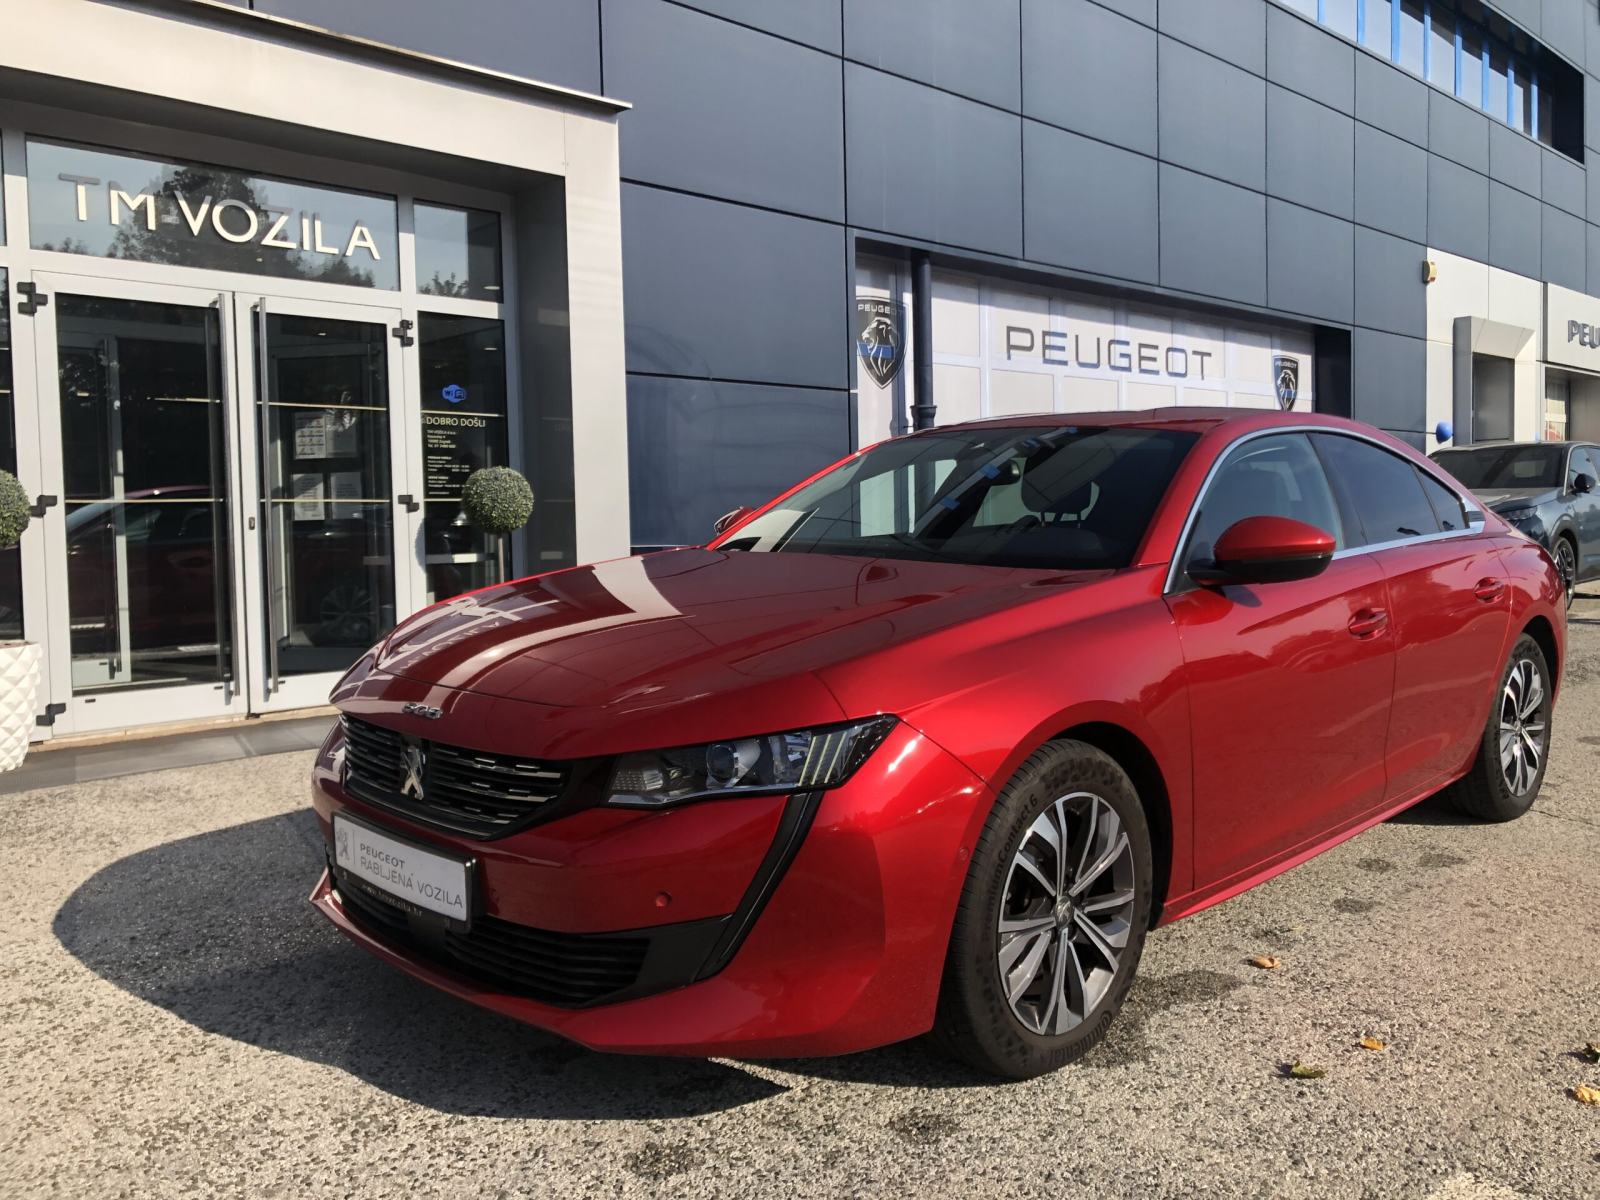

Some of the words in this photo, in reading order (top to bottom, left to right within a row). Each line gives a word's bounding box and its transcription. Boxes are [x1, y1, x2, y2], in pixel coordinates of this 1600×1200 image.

[173, 189, 381, 261] VOZILA
[1006, 325, 1212, 381] PEUGEOT
[426, 416, 459, 427] DOBRO
[460, 417, 486, 428] DOŠLI
[360, 843, 405, 870] PEUGEOT
[360, 856, 414, 890] RABLJENA
[416, 879, 463, 908] VOZILA
